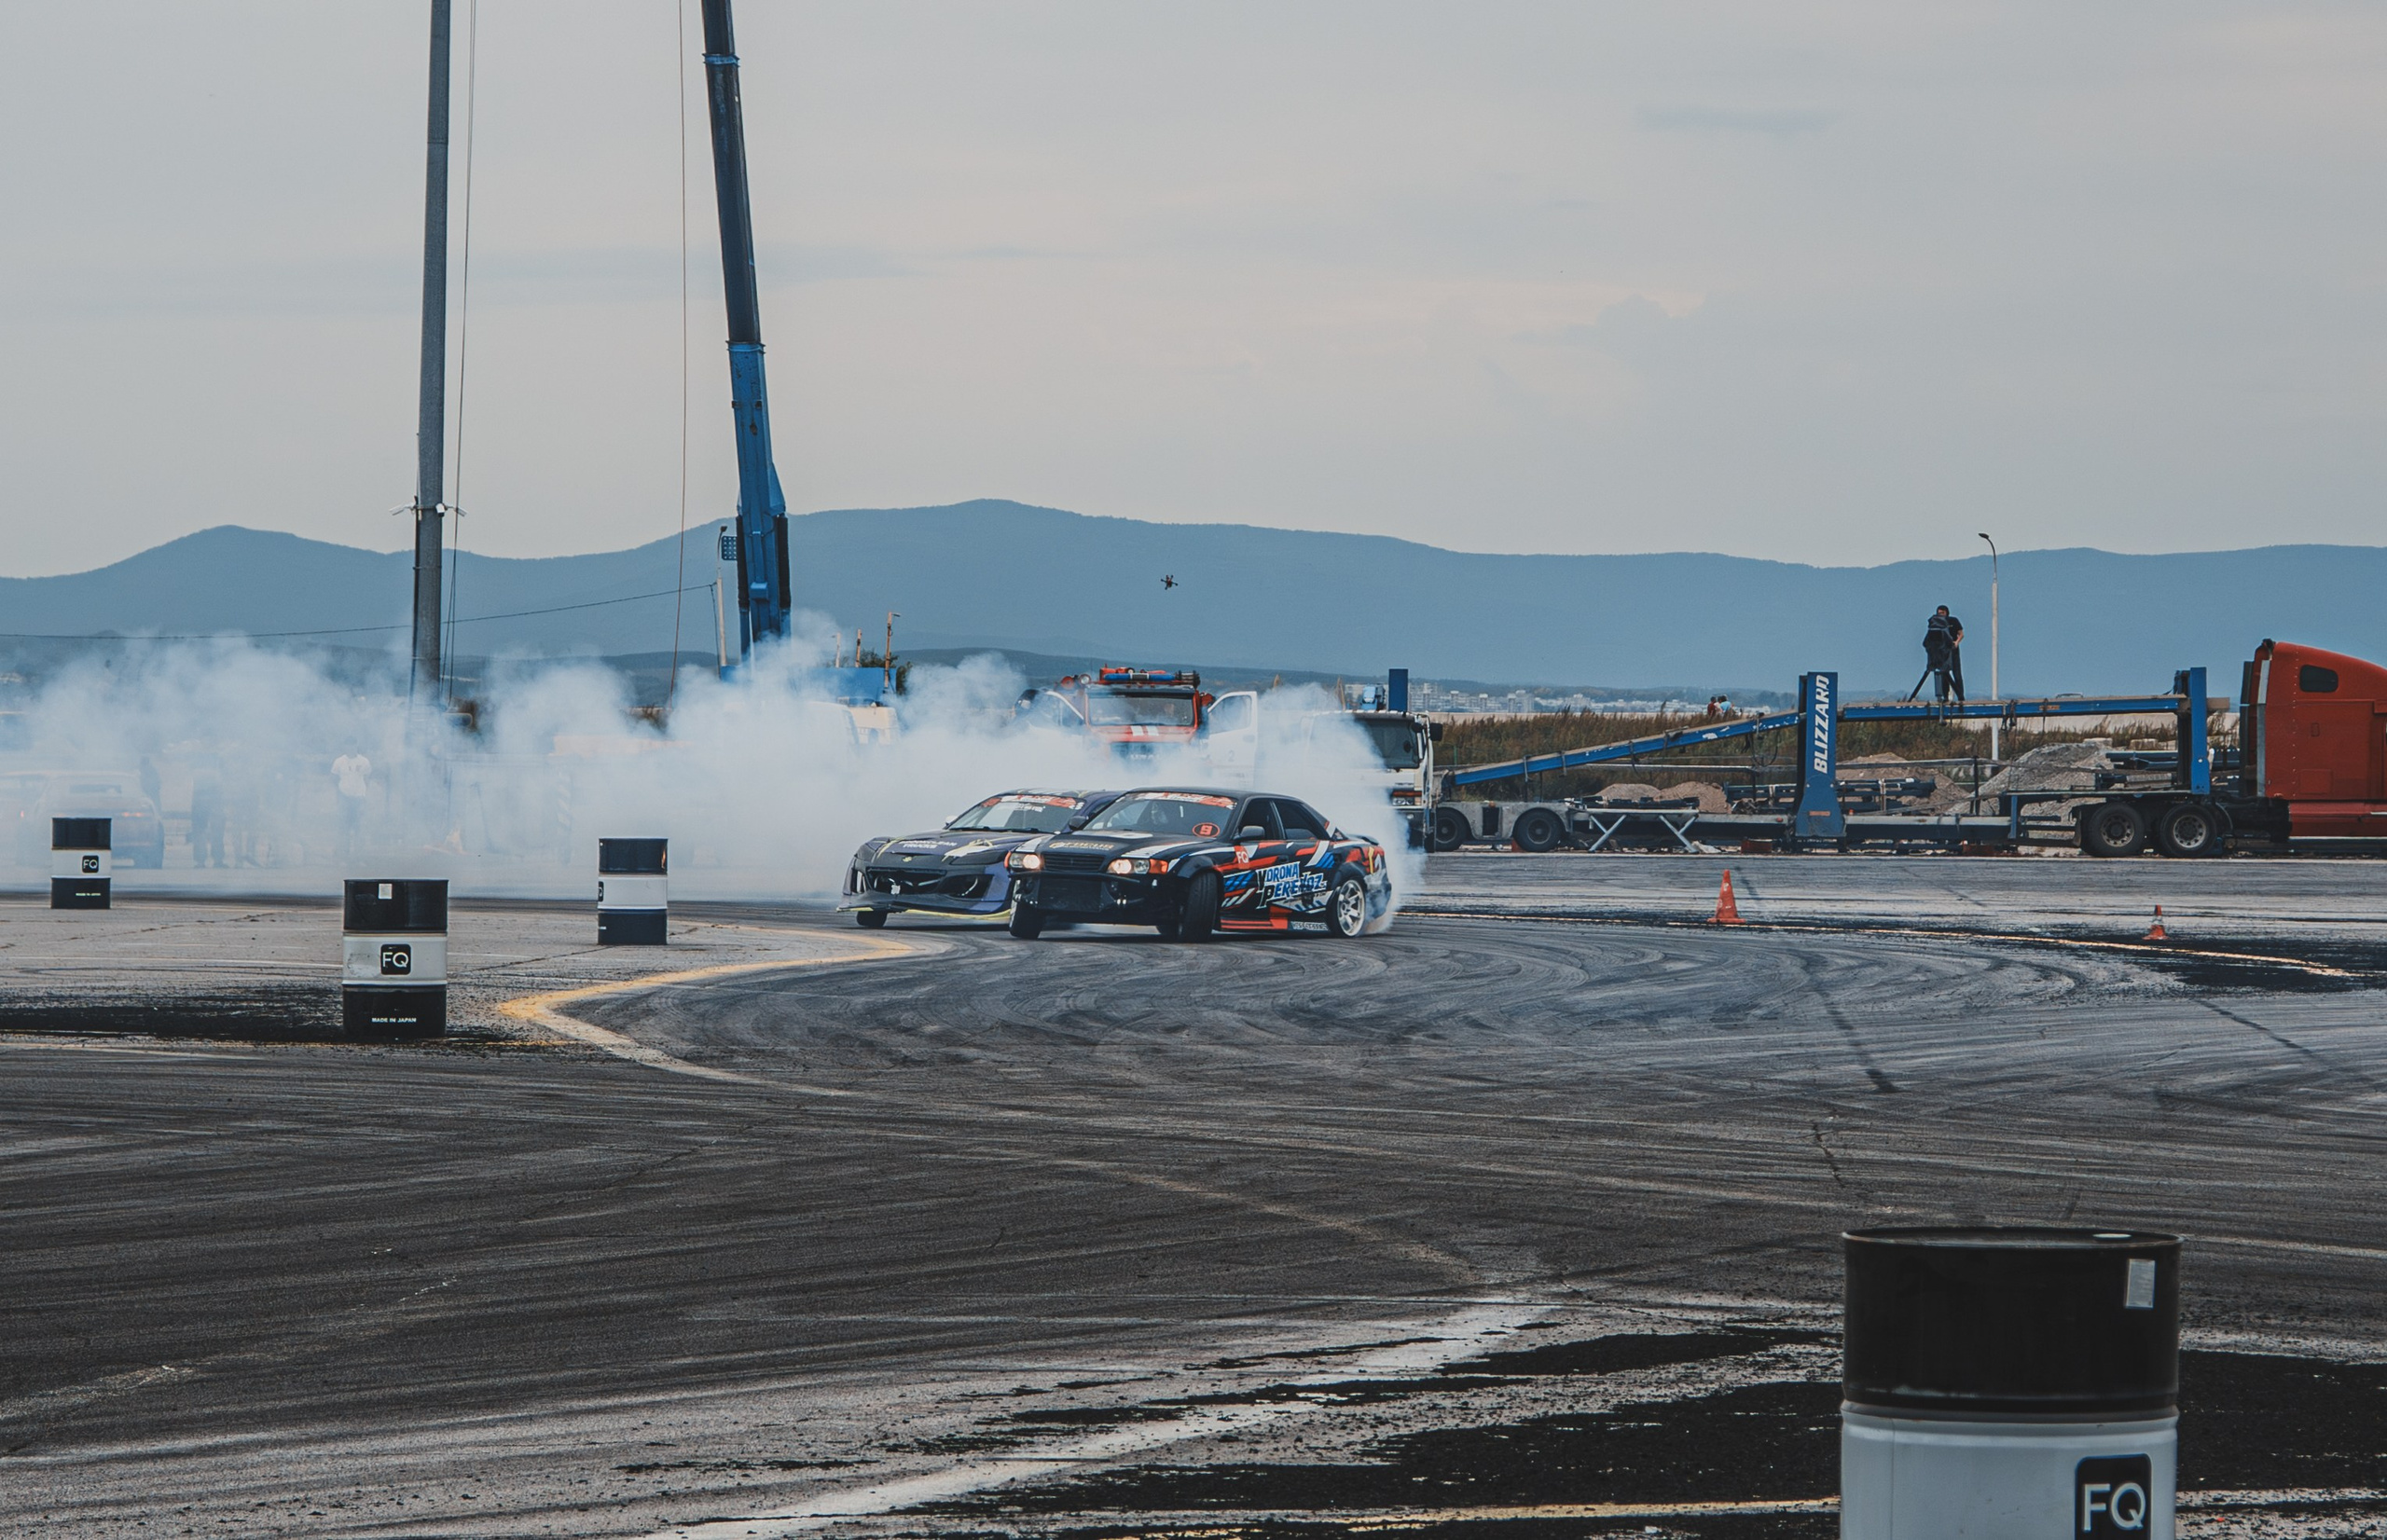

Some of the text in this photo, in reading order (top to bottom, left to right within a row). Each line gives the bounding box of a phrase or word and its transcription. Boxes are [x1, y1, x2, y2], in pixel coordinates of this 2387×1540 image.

[1814, 674, 1829, 774] BLIZZARD
[83, 859, 98, 869] FQ
[1236, 851, 1249, 863] FQ
[1255, 861, 1301, 893] VORONA
[382, 952, 408, 968] FQ
[2084, 1482, 2146, 1532] FQ
